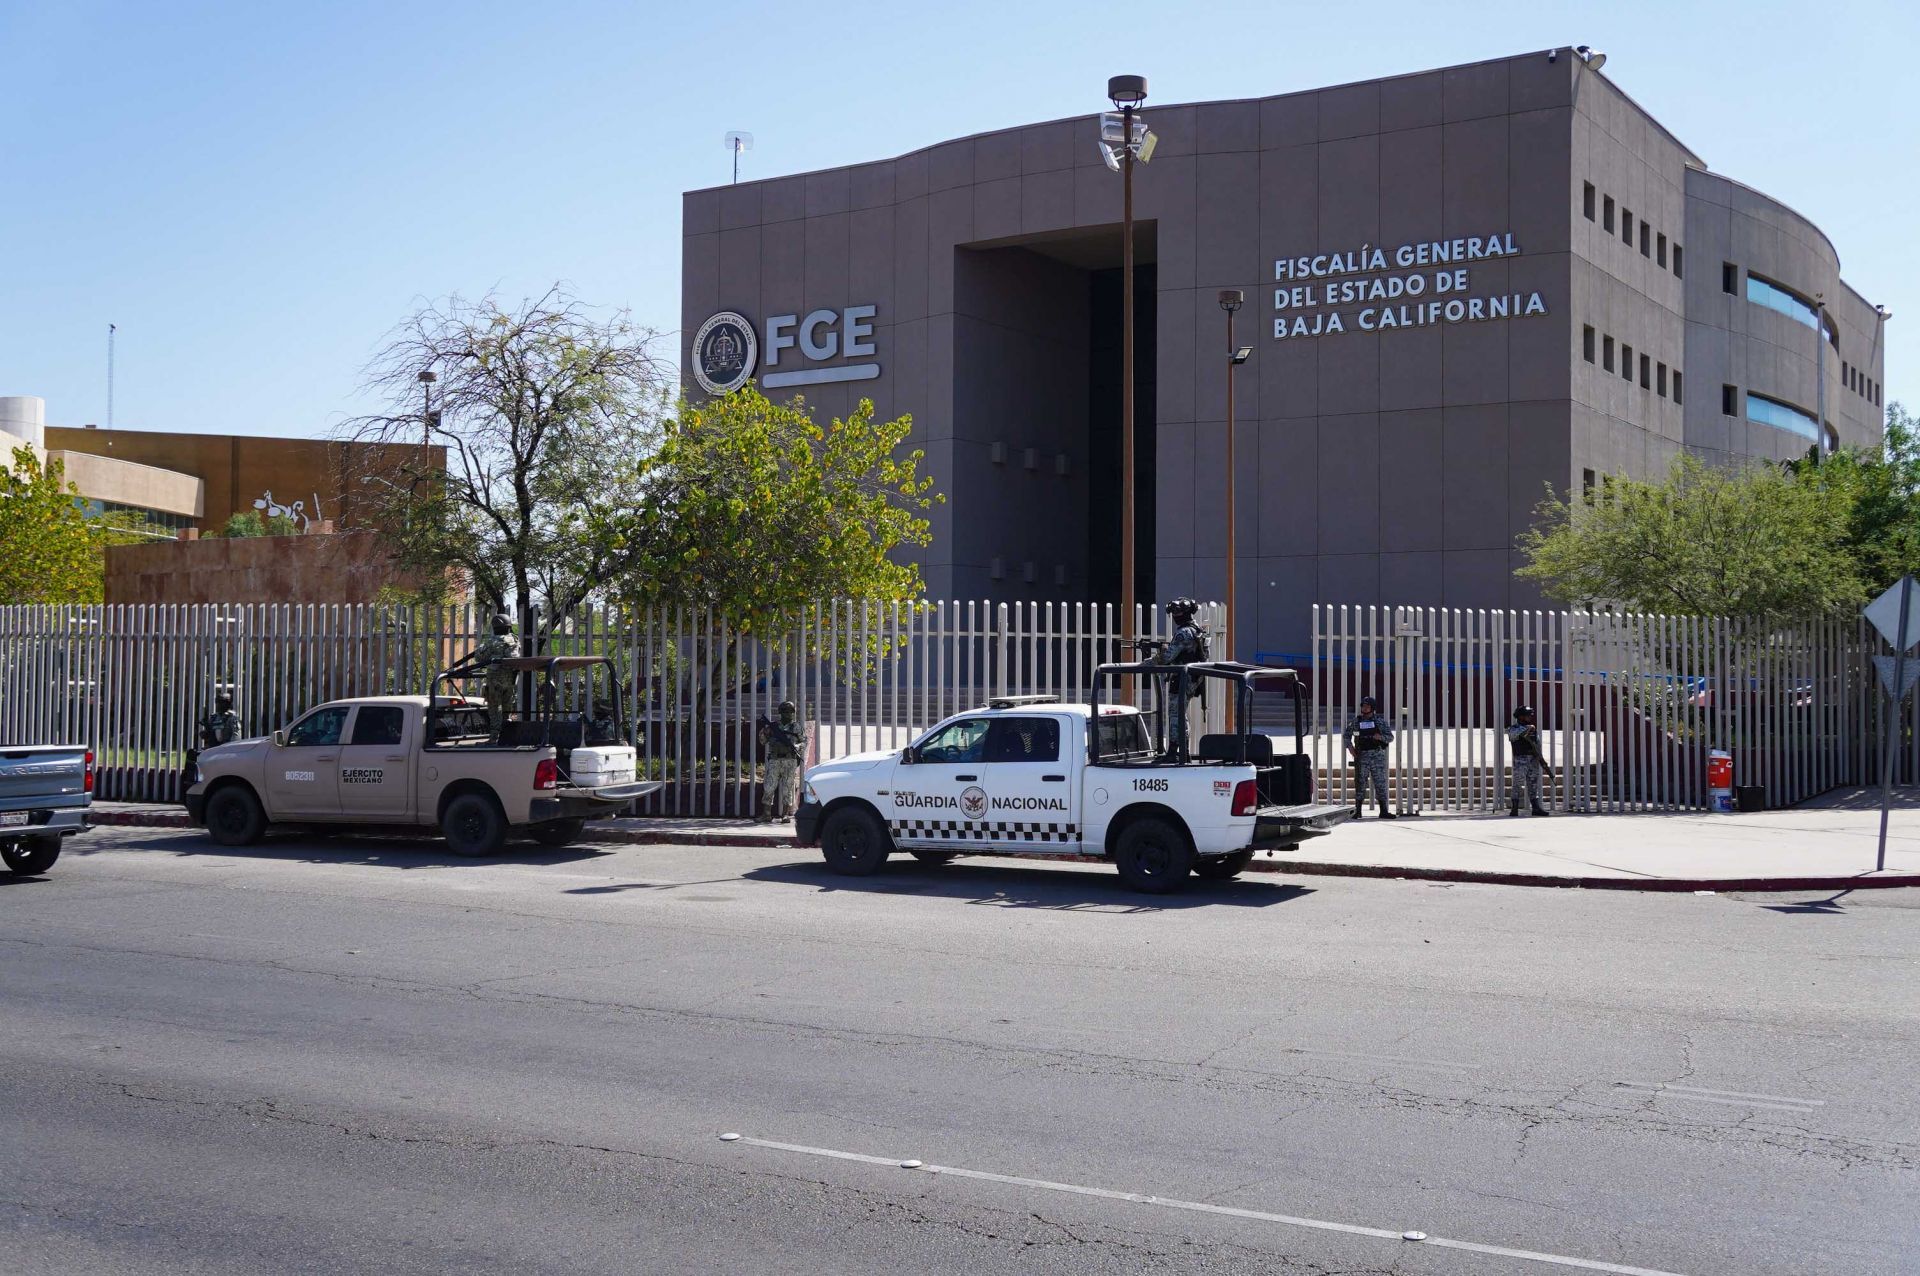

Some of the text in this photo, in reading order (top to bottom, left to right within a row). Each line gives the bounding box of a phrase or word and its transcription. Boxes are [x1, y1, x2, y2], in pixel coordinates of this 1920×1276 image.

[1275, 233, 1519, 280] FISCALÍA GENERAL
[1275, 269, 1468, 310] DEL ESTADO DE
[708, 317, 731, 329] GENERAL
[731, 318, 741, 326] DEL
[740, 323, 753, 346] ESTADO
[766, 305, 876, 366] FGE
[1274, 292, 1546, 338] BAJA CALIFORNIA
[894, 795, 1068, 811] GUARDIA NACIONAL
[1132, 779, 1169, 791] 18485
